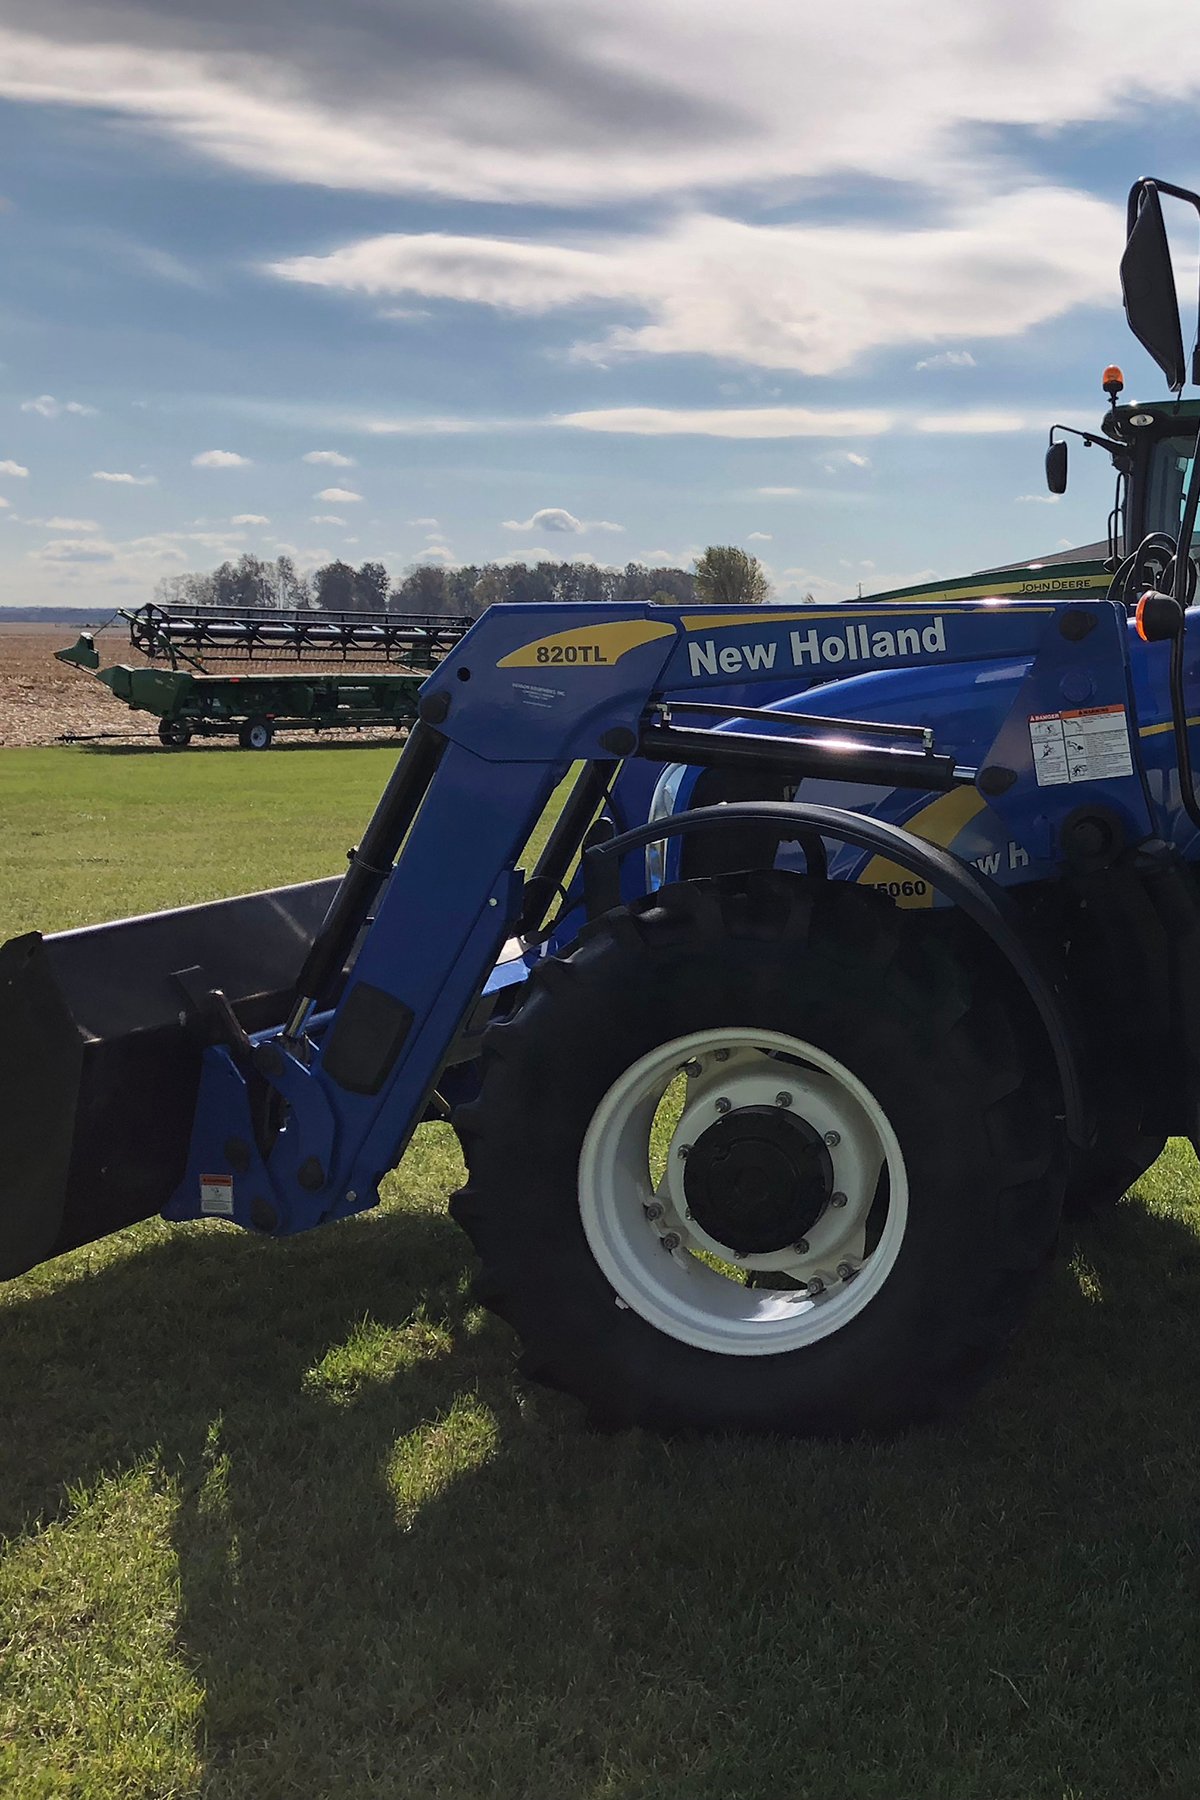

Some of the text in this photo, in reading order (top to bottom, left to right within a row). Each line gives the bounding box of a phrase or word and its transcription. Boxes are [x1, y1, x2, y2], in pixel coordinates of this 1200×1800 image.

[1020, 579, 1091, 593] JOHN DEERE
[536, 644, 607, 666] 820TL
[688, 616, 947, 677] New Holland
[1035, 713, 1060, 721] DANGER
